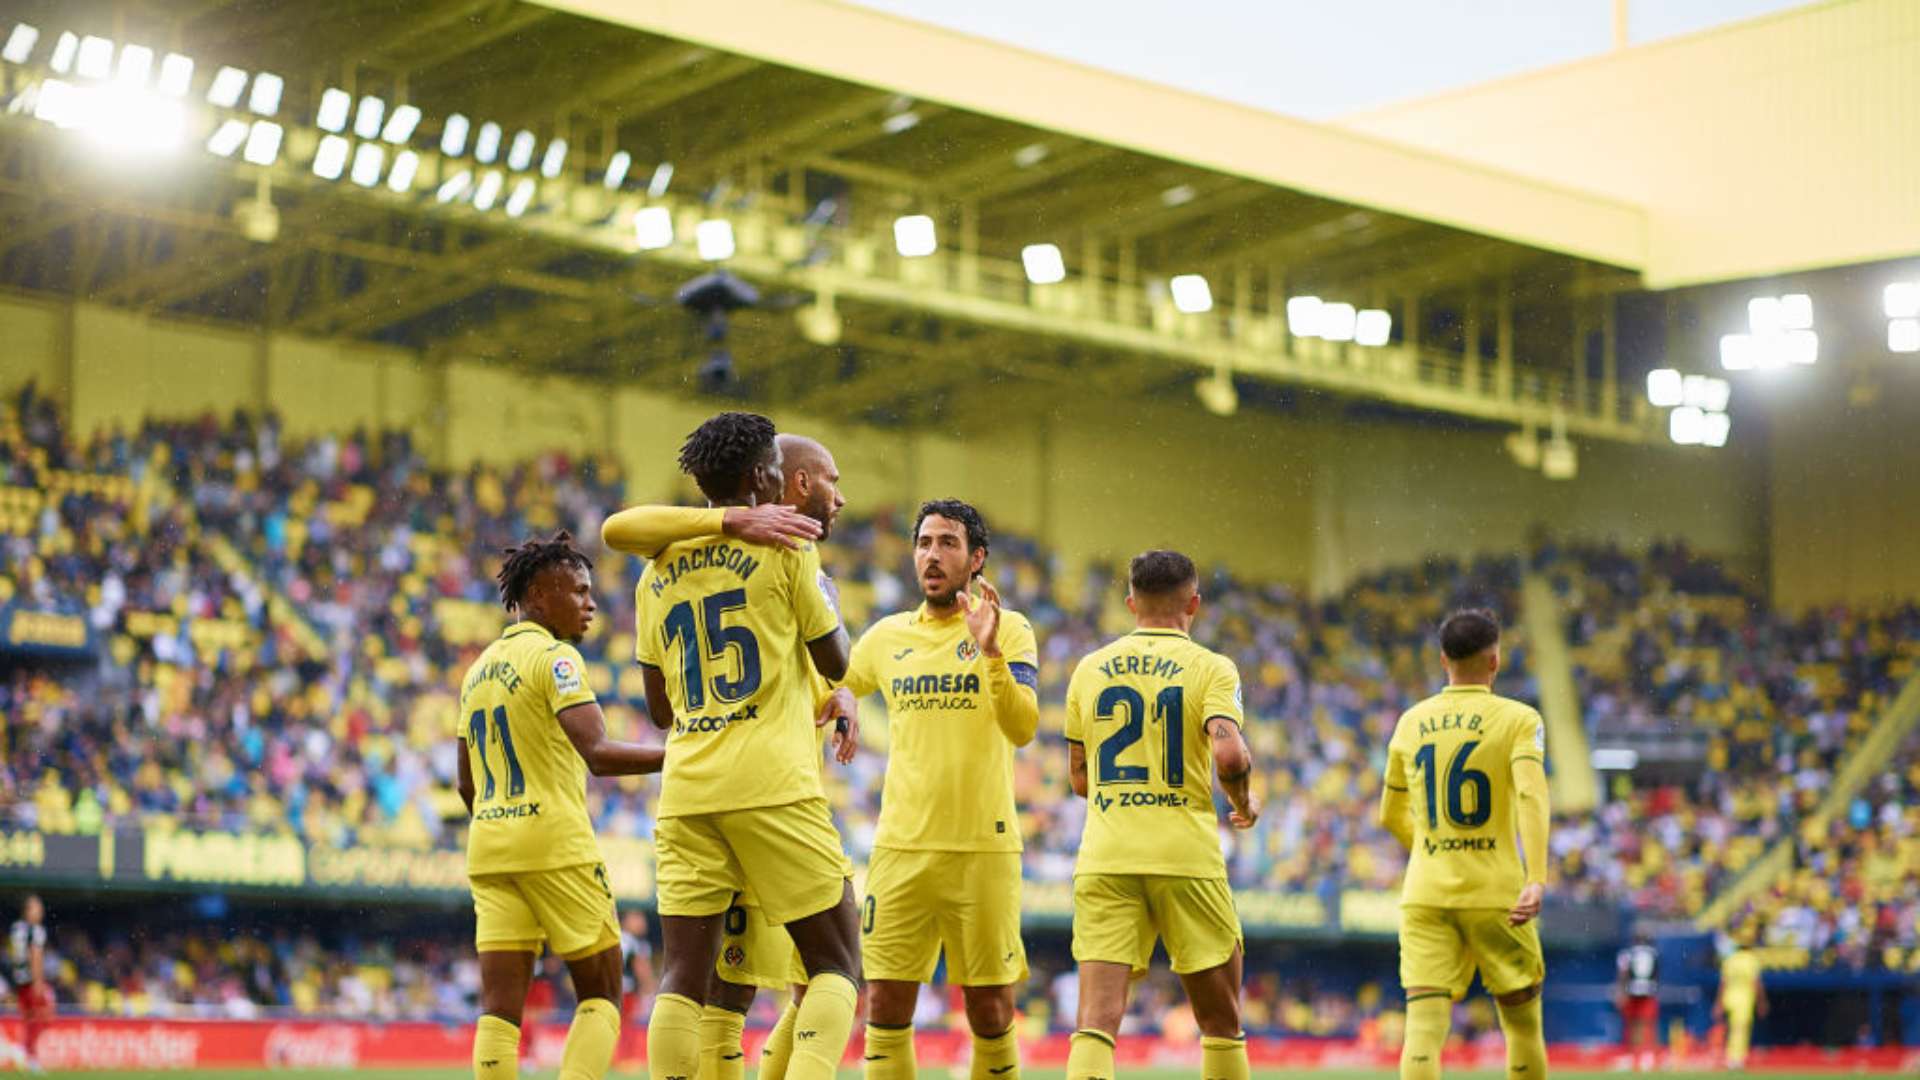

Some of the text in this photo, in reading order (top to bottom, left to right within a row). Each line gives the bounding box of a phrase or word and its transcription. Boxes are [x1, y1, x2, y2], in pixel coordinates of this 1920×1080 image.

[660, 588, 762, 713] 15
[1099, 654, 1184, 680] YEREMY
[469, 704, 525, 800] 11
[1094, 685, 1184, 788] 21
[1419, 714, 1483, 737] ALEX B.
[1414, 740, 1491, 830] 16
